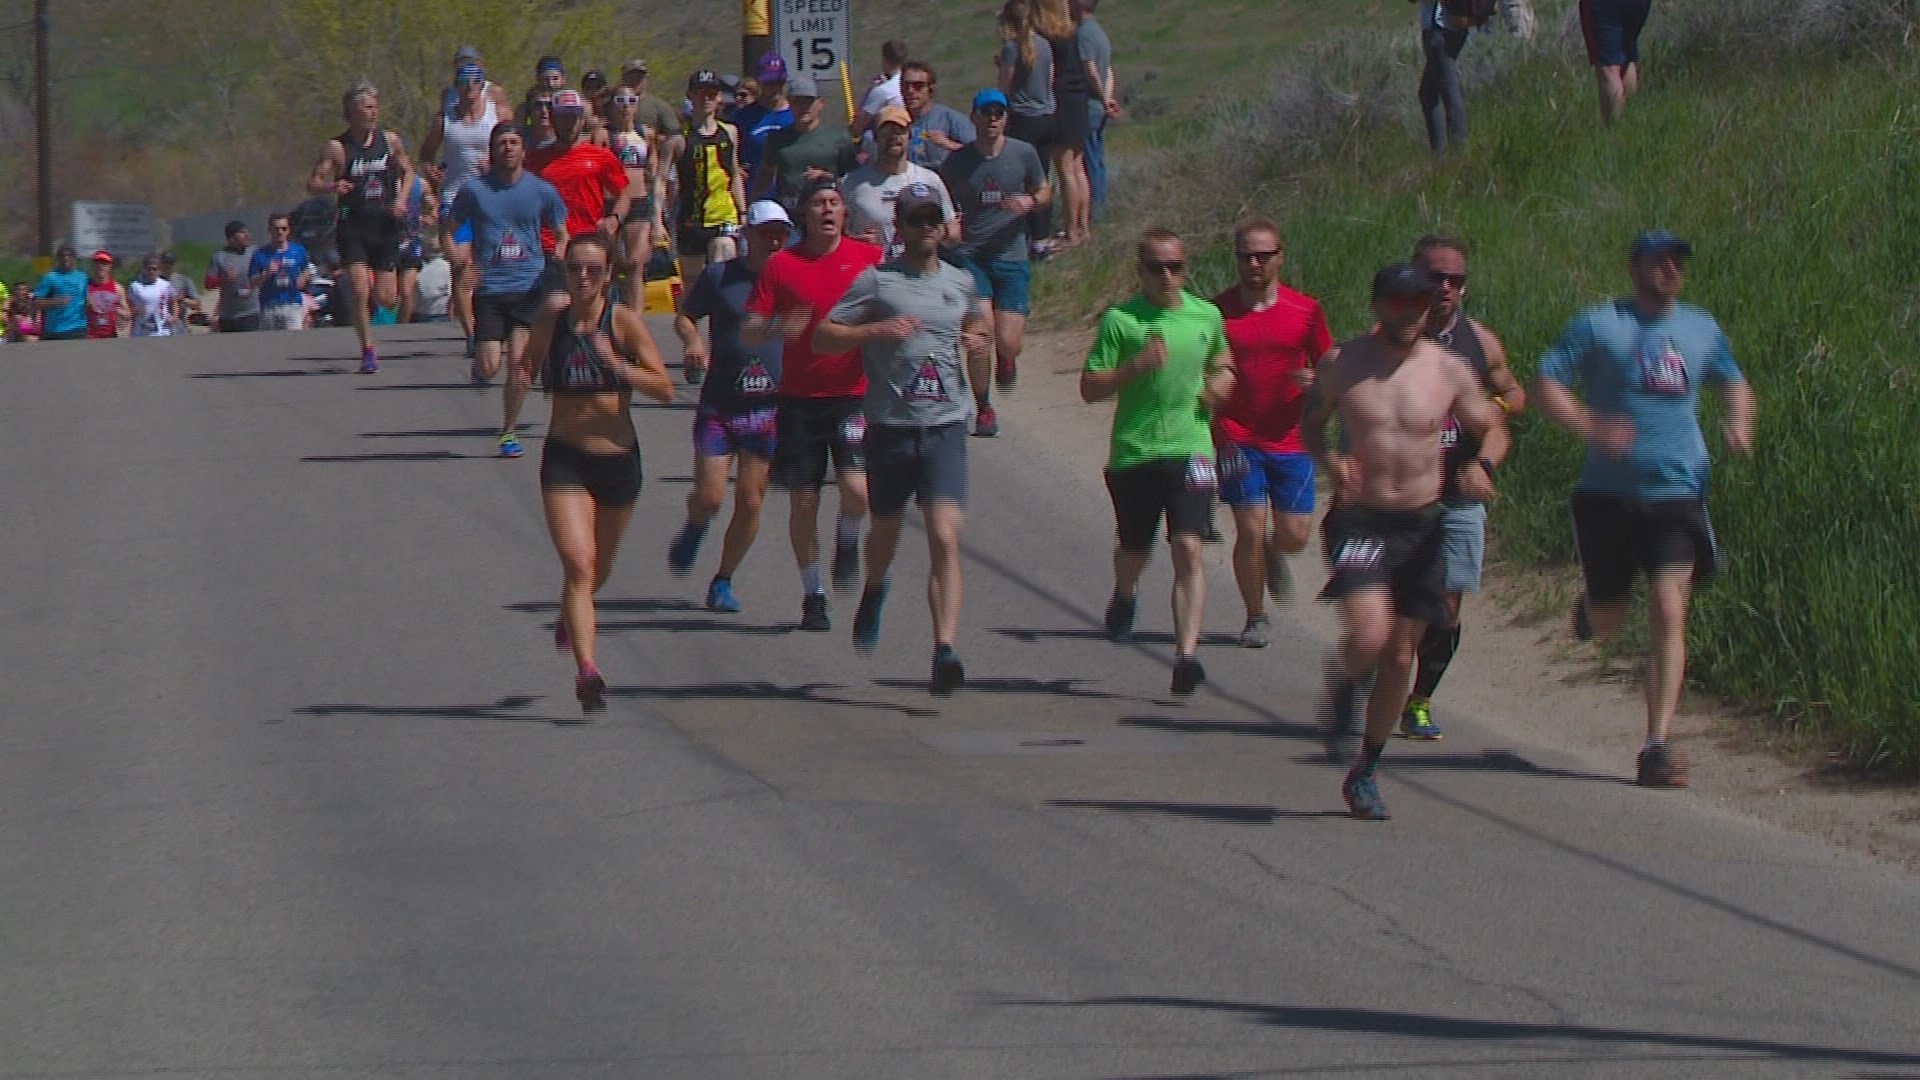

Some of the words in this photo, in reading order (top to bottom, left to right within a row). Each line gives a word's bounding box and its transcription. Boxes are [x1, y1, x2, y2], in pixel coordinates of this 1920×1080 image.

[783, 0, 843, 14] SPEED
[790, 17, 837, 33] LIMIT
[792, 37, 835, 71] 15
